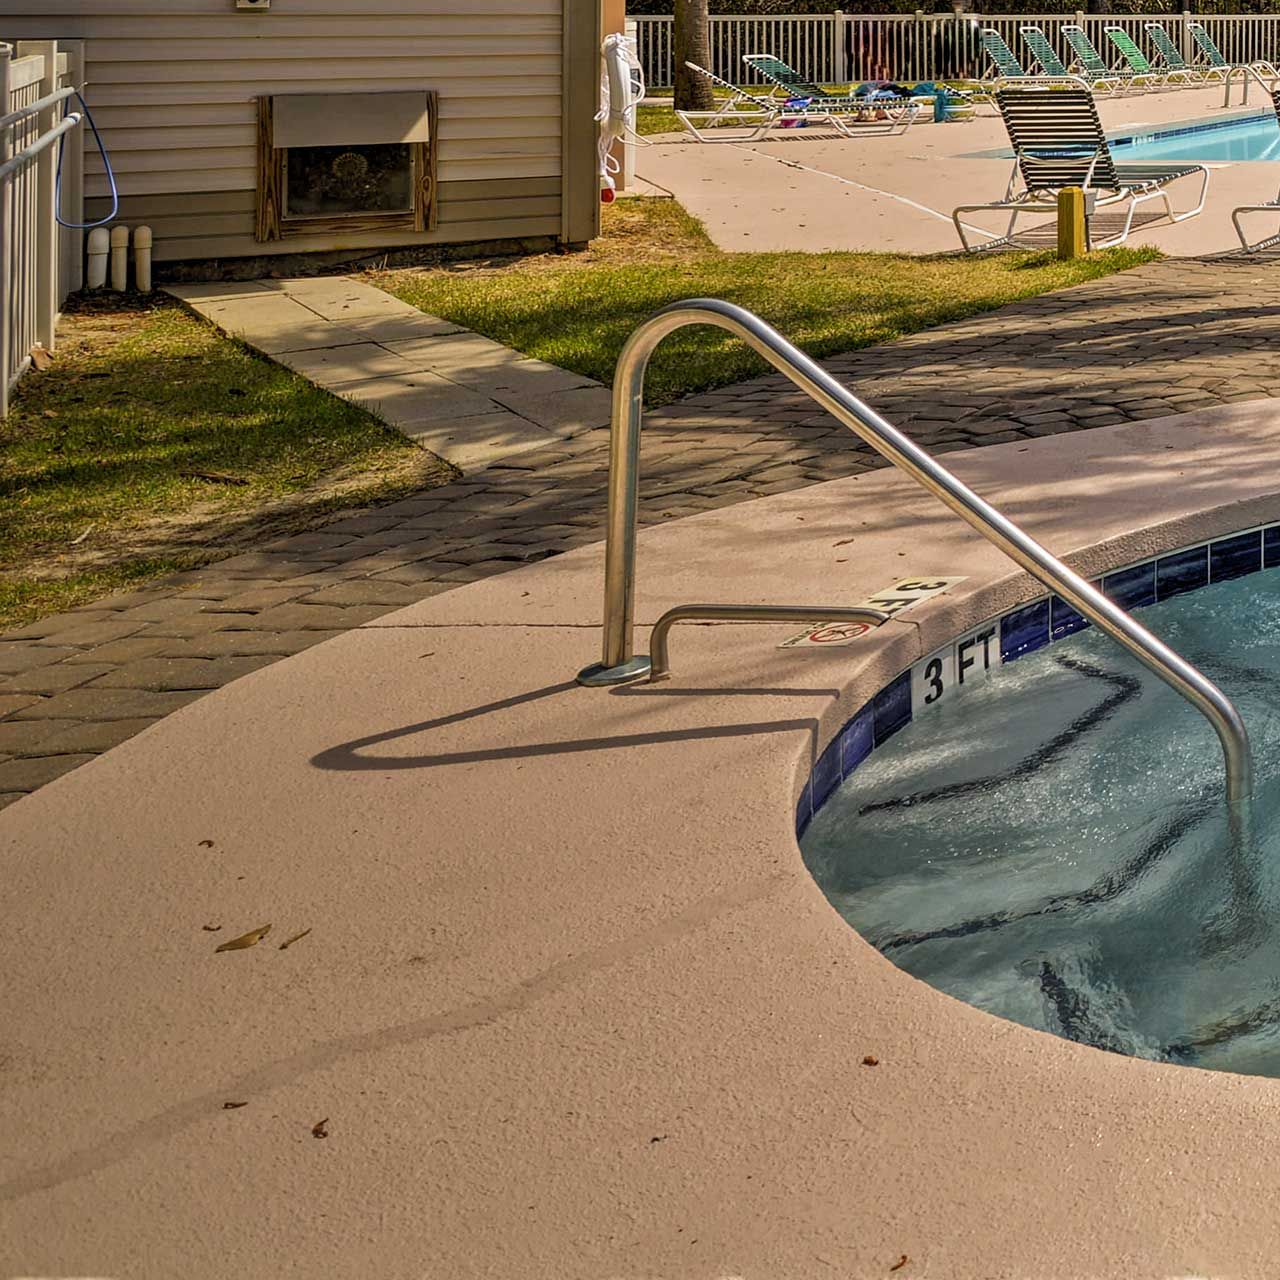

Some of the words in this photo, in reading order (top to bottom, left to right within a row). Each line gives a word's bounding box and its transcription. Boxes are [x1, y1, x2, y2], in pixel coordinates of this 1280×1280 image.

[896, 581, 948, 591] 3
[924, 658, 944, 705] 3
[958, 626, 996, 685] FT
